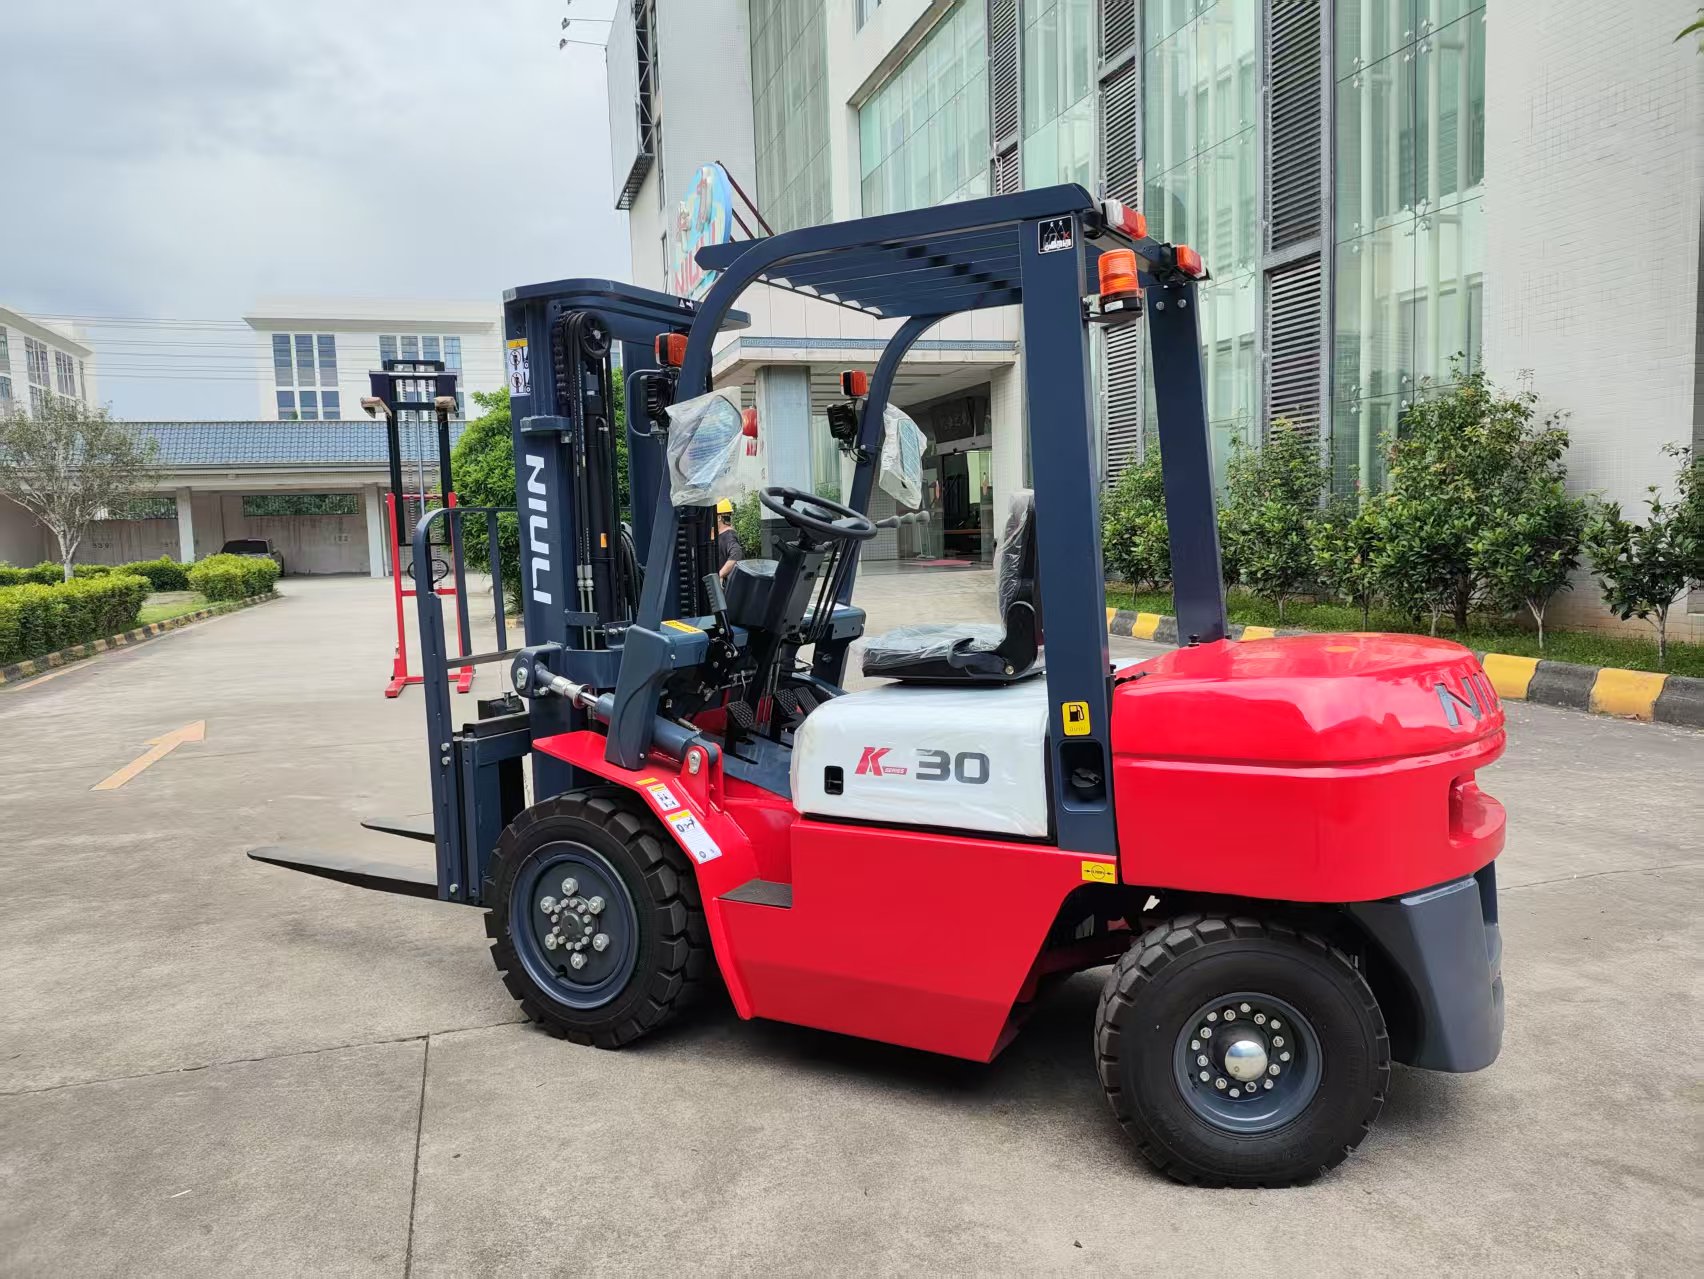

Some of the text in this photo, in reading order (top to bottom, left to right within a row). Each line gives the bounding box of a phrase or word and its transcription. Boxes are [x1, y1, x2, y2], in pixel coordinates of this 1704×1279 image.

[526, 454, 552, 605] NIULI
[855, 746, 892, 776] K
[915, 748, 990, 784] 30
